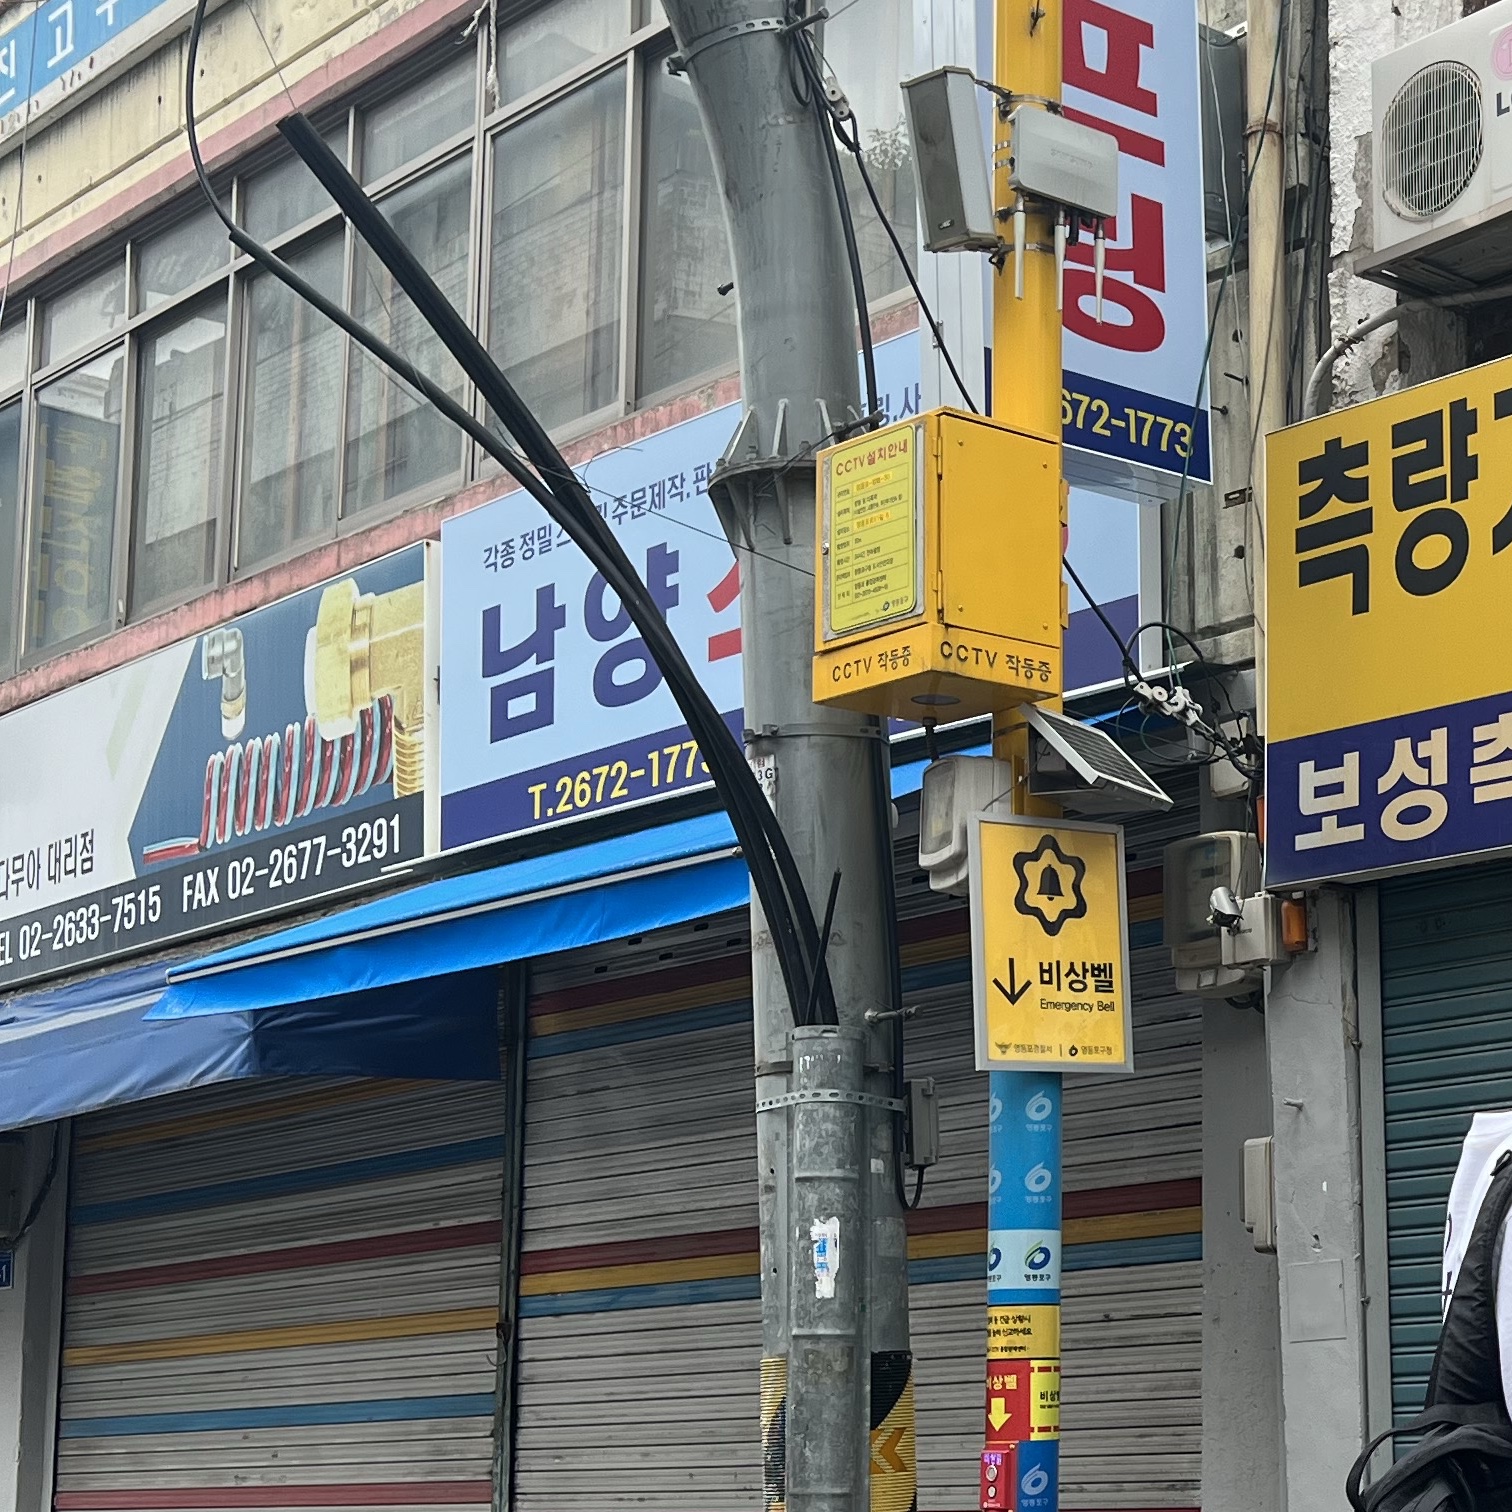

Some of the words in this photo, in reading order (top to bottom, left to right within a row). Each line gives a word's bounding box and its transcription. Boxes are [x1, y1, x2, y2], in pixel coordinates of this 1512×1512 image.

[483, 540, 517, 573] 각종
[518, 526, 553, 563] 정밀
[832, 655, 873, 682] CCTV
[877, 645, 912, 674] 작동중
[940, 641, 998, 669] CCTV
[1005, 654, 1052, 682] 작동중
[528, 741, 710, 821] T.2672-177
[47, 829, 95, 886] 대리점
[19, 885, 162, 962] 02-2633-7515
[182, 873, 221, 913] FAX
[227, 812, 401, 901] 02-2677-3291
[1038, 960, 1115, 994] 비상벨
[1039, 998, 1094, 1013] Emergency
[1097, 1000, 1115, 1012] Bell
